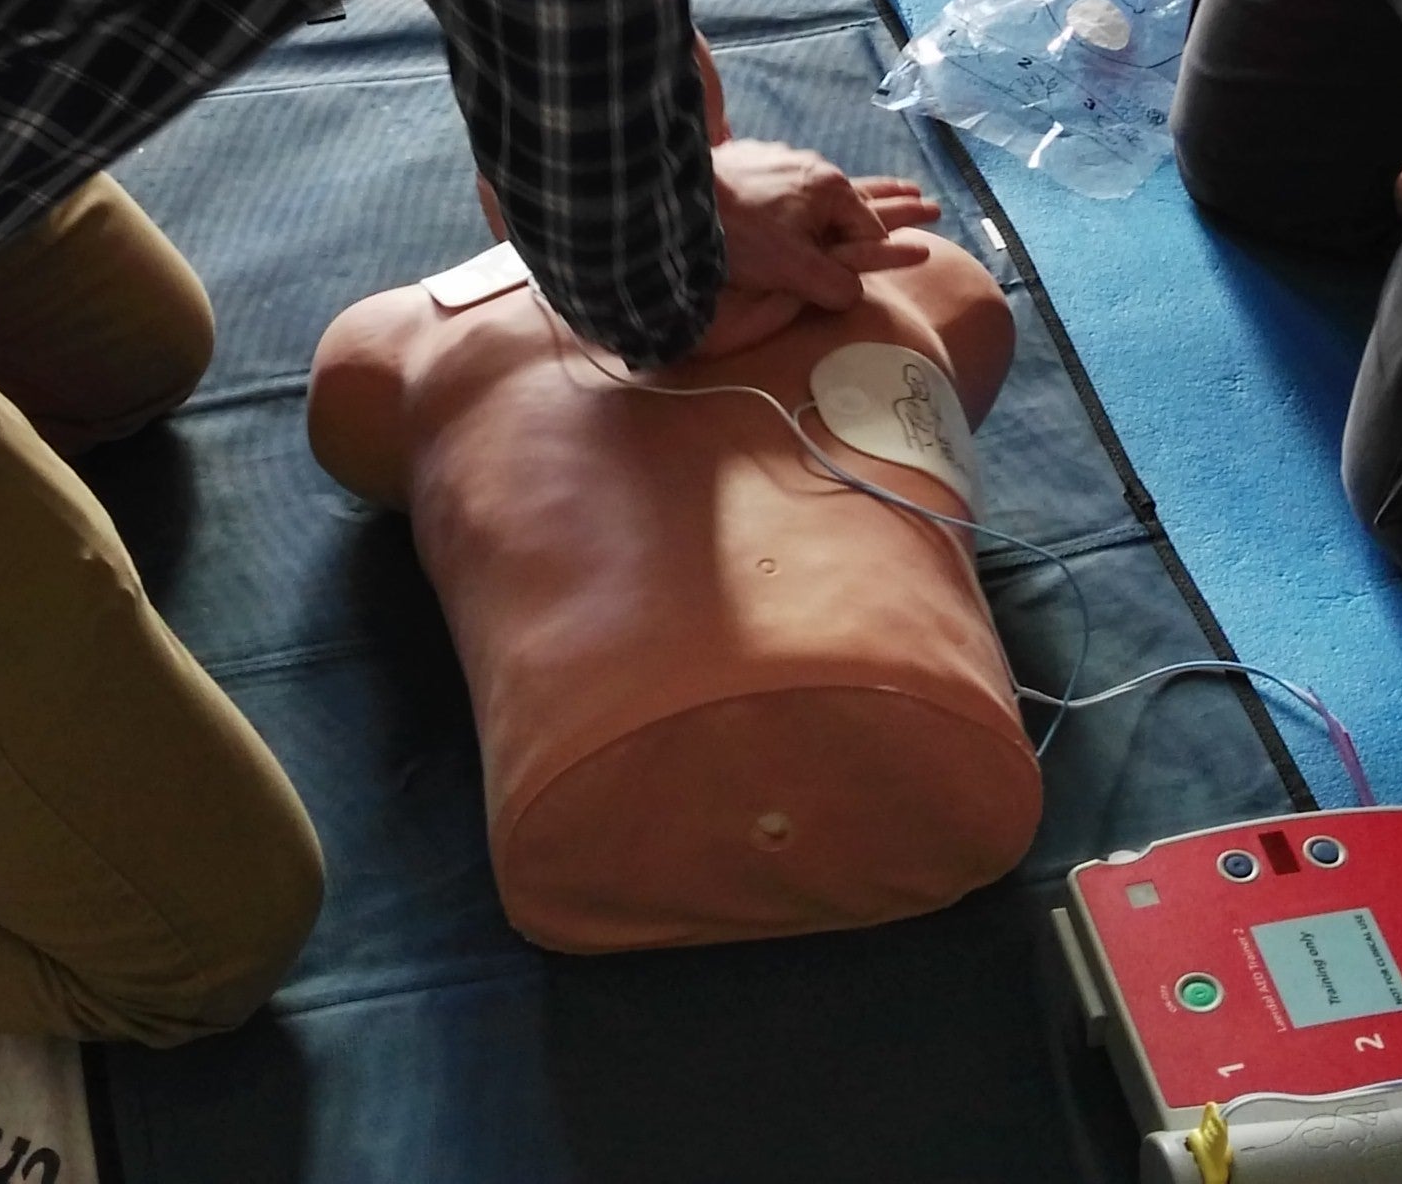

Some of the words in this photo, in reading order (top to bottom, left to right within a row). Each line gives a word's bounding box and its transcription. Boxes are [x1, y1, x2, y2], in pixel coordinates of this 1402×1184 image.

[1354, 915, 1368, 930] USE
[1238, 936, 1258, 970] Trainer
[1300, 930, 1318, 958] only
[1364, 932, 1385, 967] CLINICAL
[1253, 972, 1269, 993] AED
[1316, 959, 1342, 1006] Training
[1381, 968, 1394, 985] FOR
[1262, 995, 1287, 1033] Laerdal
[1355, 1032, 1385, 1052] 2
[1218, 1062, 1244, 1078] 1
